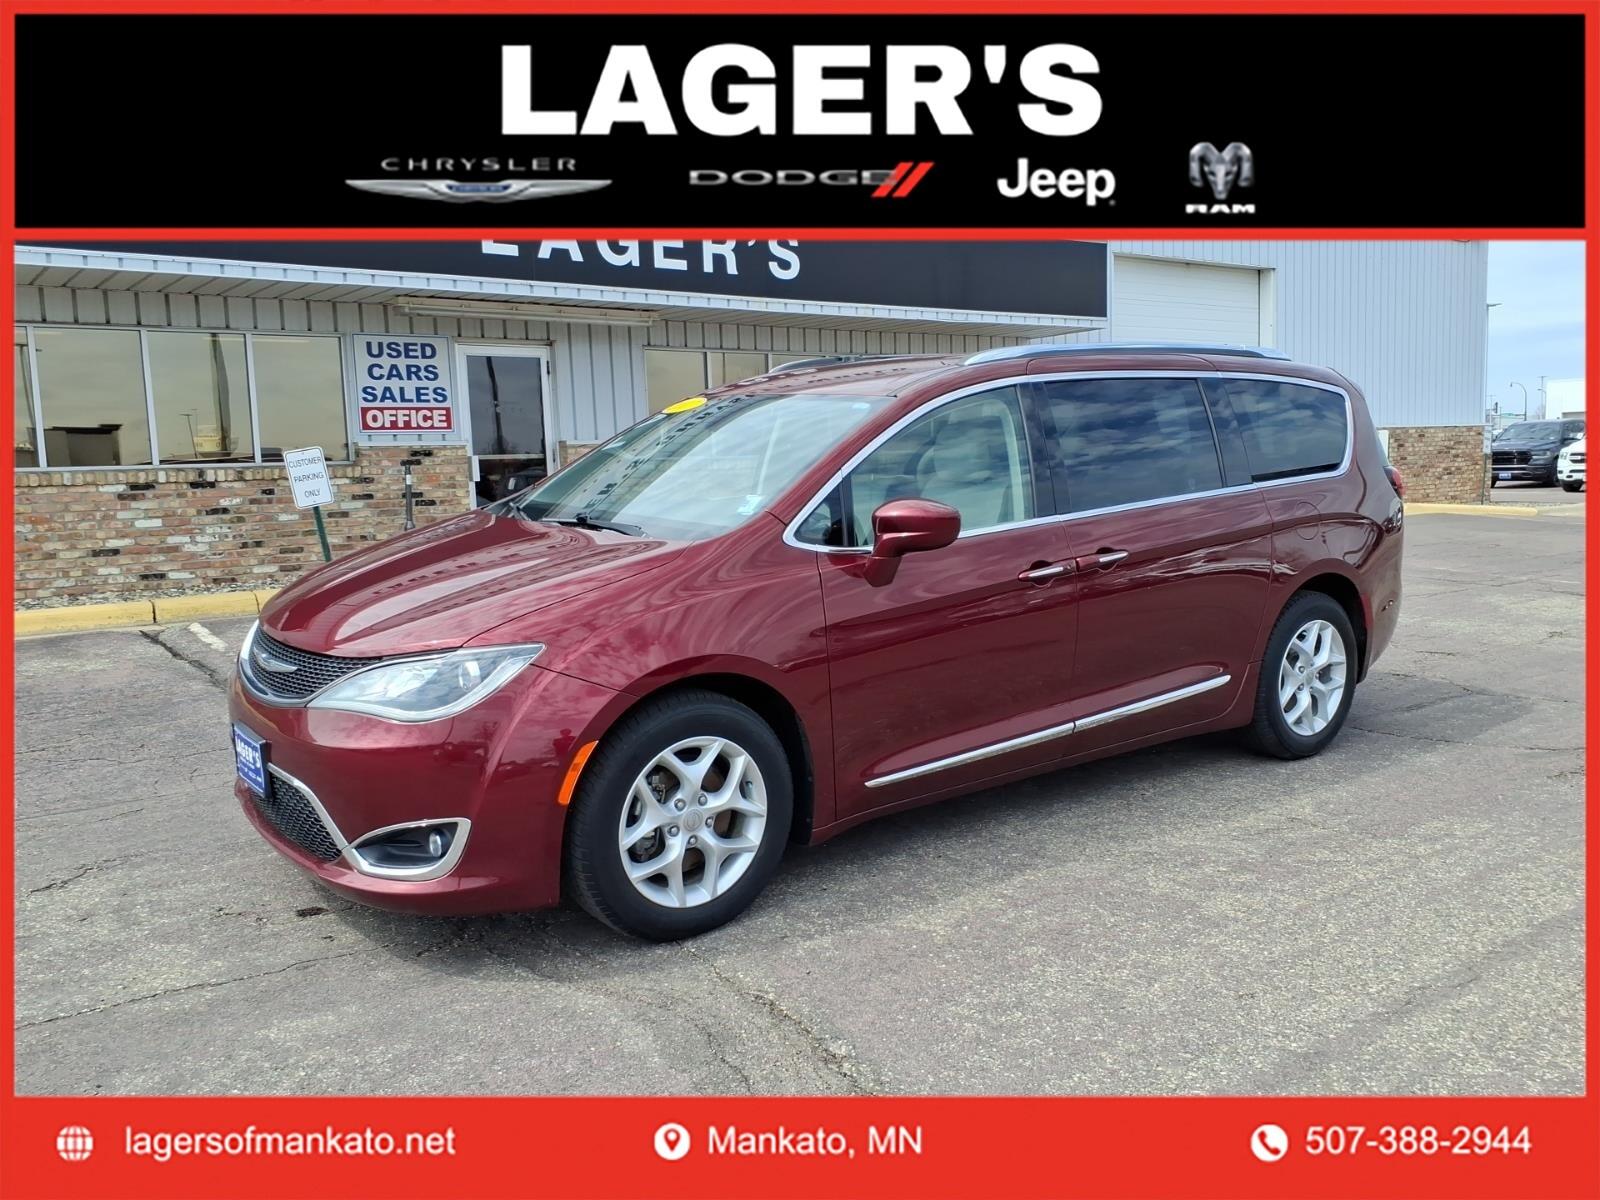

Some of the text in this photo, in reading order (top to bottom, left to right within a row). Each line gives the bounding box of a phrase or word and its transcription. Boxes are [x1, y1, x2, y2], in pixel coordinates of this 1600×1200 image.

[481, 239, 801, 280] GERS
[366, 341, 437, 359] USED
[367, 363, 439, 381] CARS
[361, 386, 448, 403] SALES
[365, 409, 448, 428] OFFICE
[288, 456, 322, 469] CUSTOMER
[293, 472, 325, 483] PARKING
[304, 489, 321, 498] ONLY
